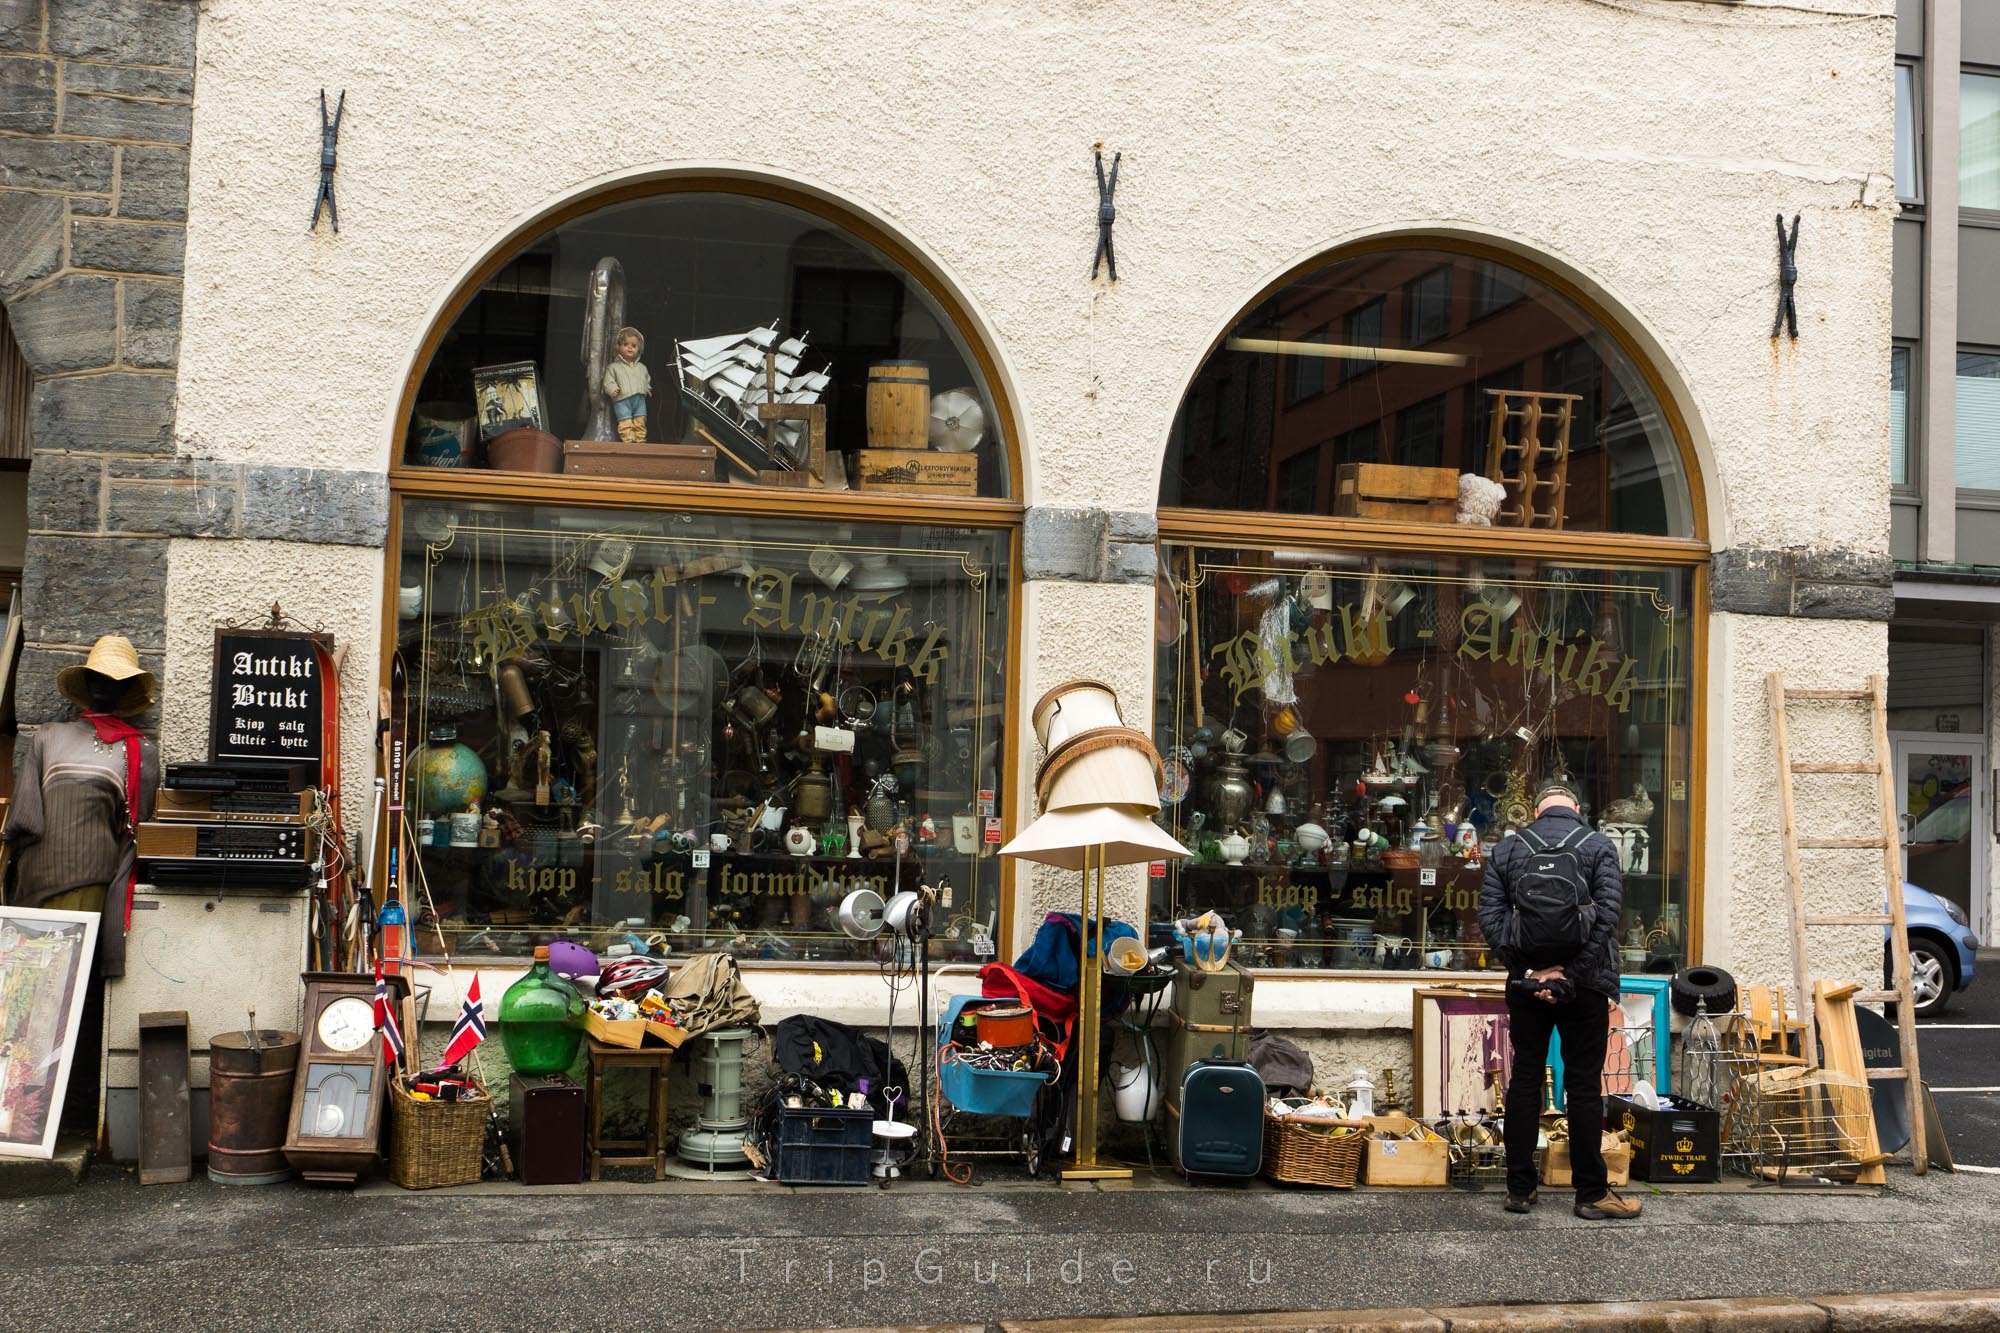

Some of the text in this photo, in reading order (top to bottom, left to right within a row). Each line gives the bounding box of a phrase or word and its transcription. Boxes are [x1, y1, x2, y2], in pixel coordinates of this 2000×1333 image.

[742, 567, 949, 685] Antikk
[231, 651, 314, 678] Antikt
[1211, 602, 1396, 707] Brukt
[1456, 602, 1639, 713] Antikk
[231, 683, 309, 709] Brukt
[234, 717, 305, 733] Kjøp salg
[228, 733, 266, 746] Utleie
[280, 735, 309, 749] bytte
[506, 858, 577, 897] kjøp
[614, 863, 686, 901] salg
[1257, 875, 1318, 914] kjøp
[1351, 879, 1413, 915] salg
[1862, 1047, 1893, 1060] igital
